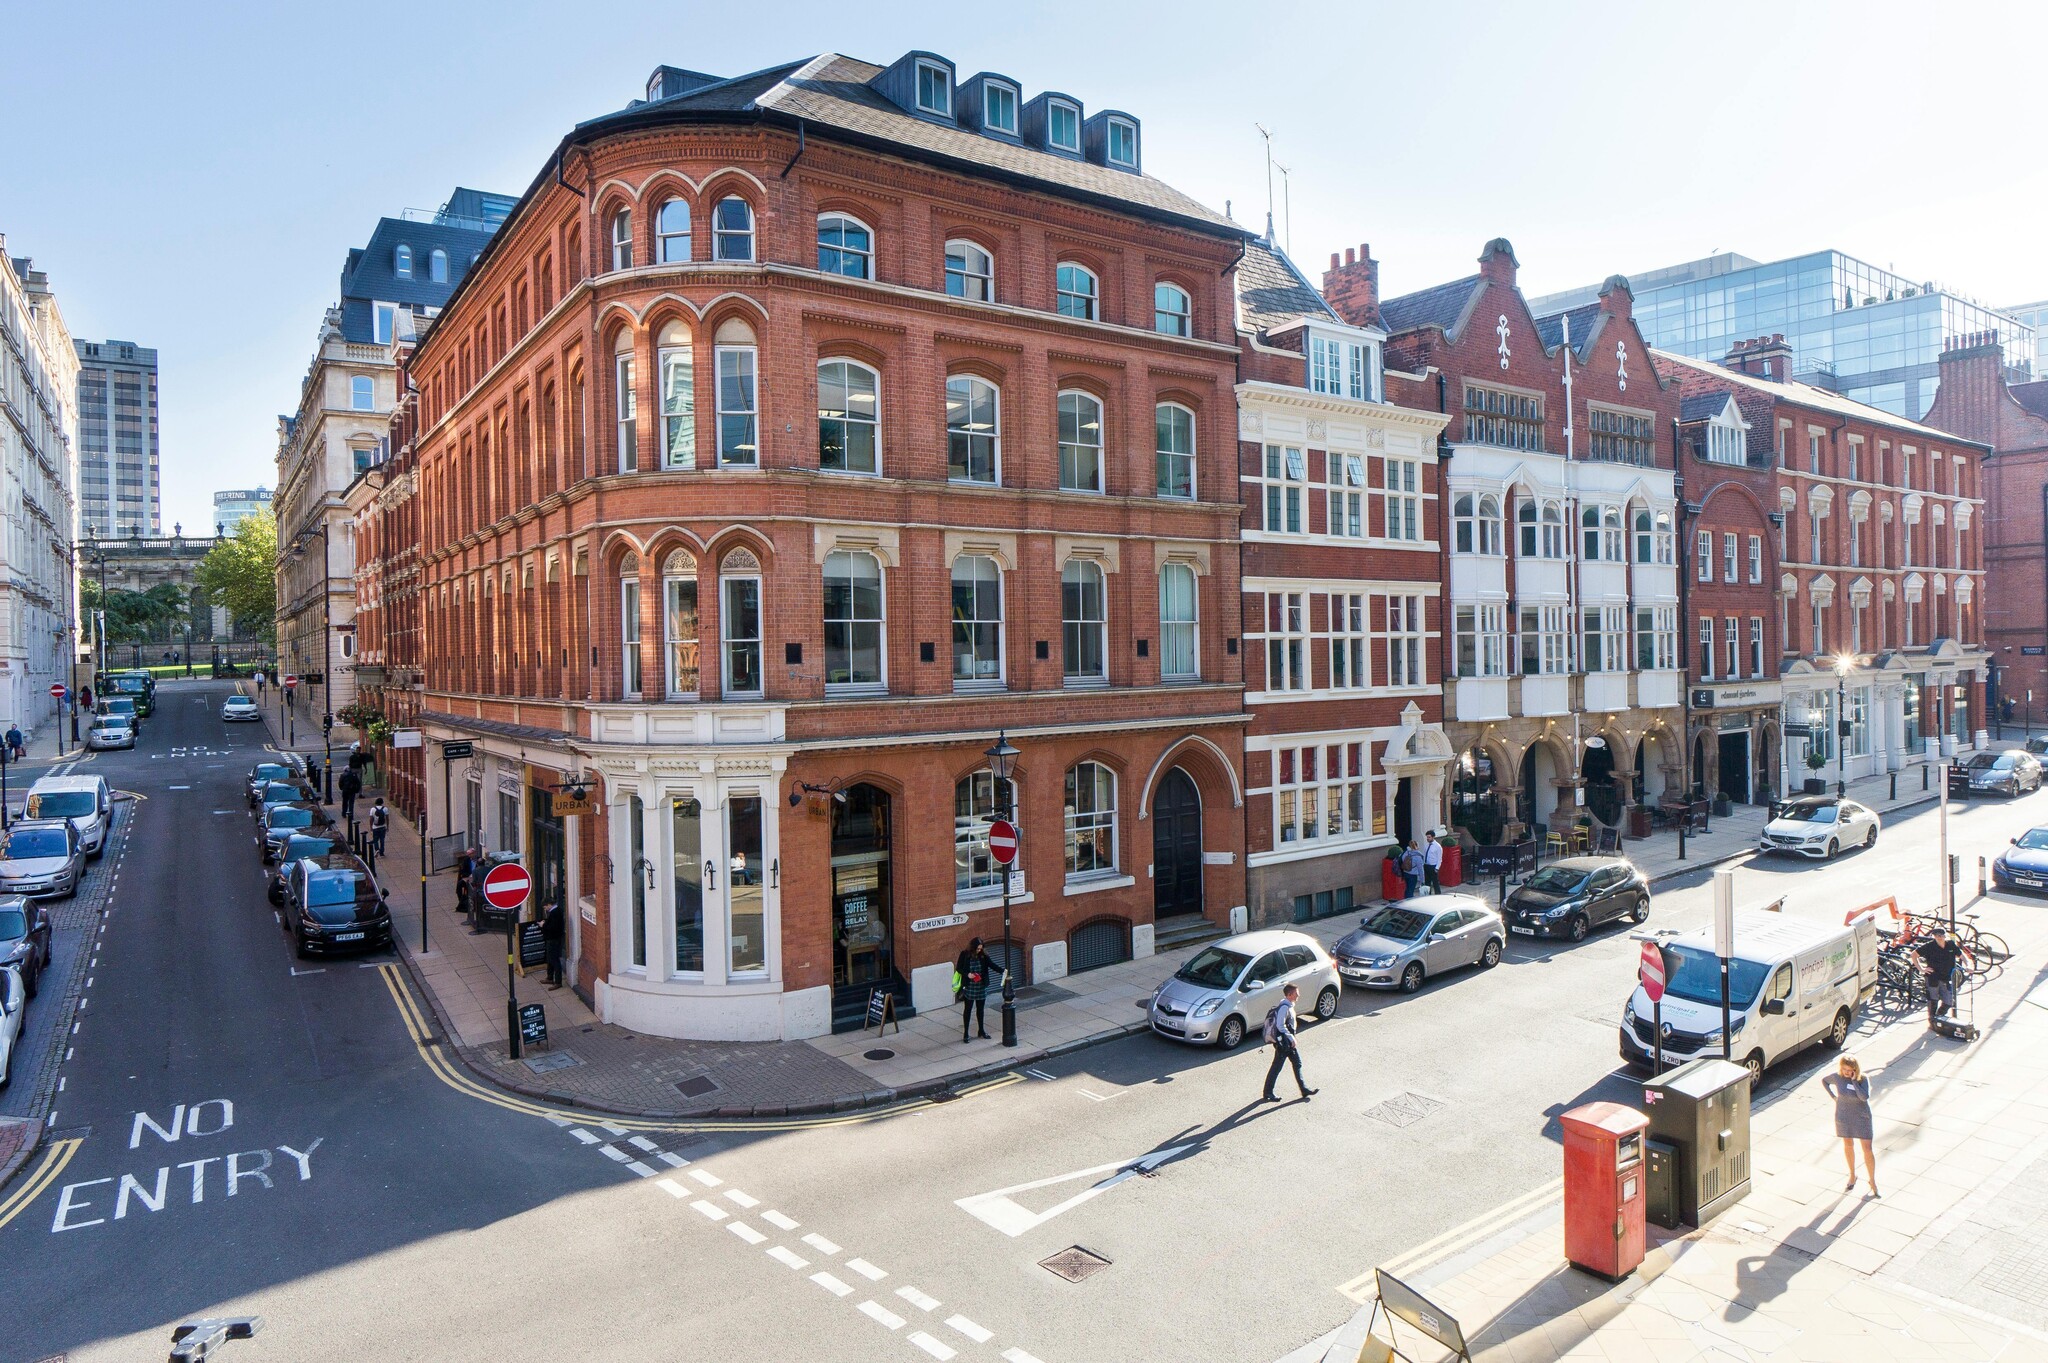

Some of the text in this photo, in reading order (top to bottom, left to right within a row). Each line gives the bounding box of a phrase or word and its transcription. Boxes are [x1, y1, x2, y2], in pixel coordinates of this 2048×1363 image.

[151, 750, 234, 759] ENTRY
[555, 800, 590, 810] URBAN
[808, 806, 826, 817] URBAN
[844, 901, 868, 915] COFFEE
[845, 916, 868, 926] RELAX
[917, 919, 946, 930] EDMUND
[1800, 956, 1825, 979] principal
[523, 1009, 540, 1017] URBAN
[1660, 1003, 1690, 1013] principal
[129, 1098, 235, 1149] NO
[51, 1137, 325, 1233] ENTRY
